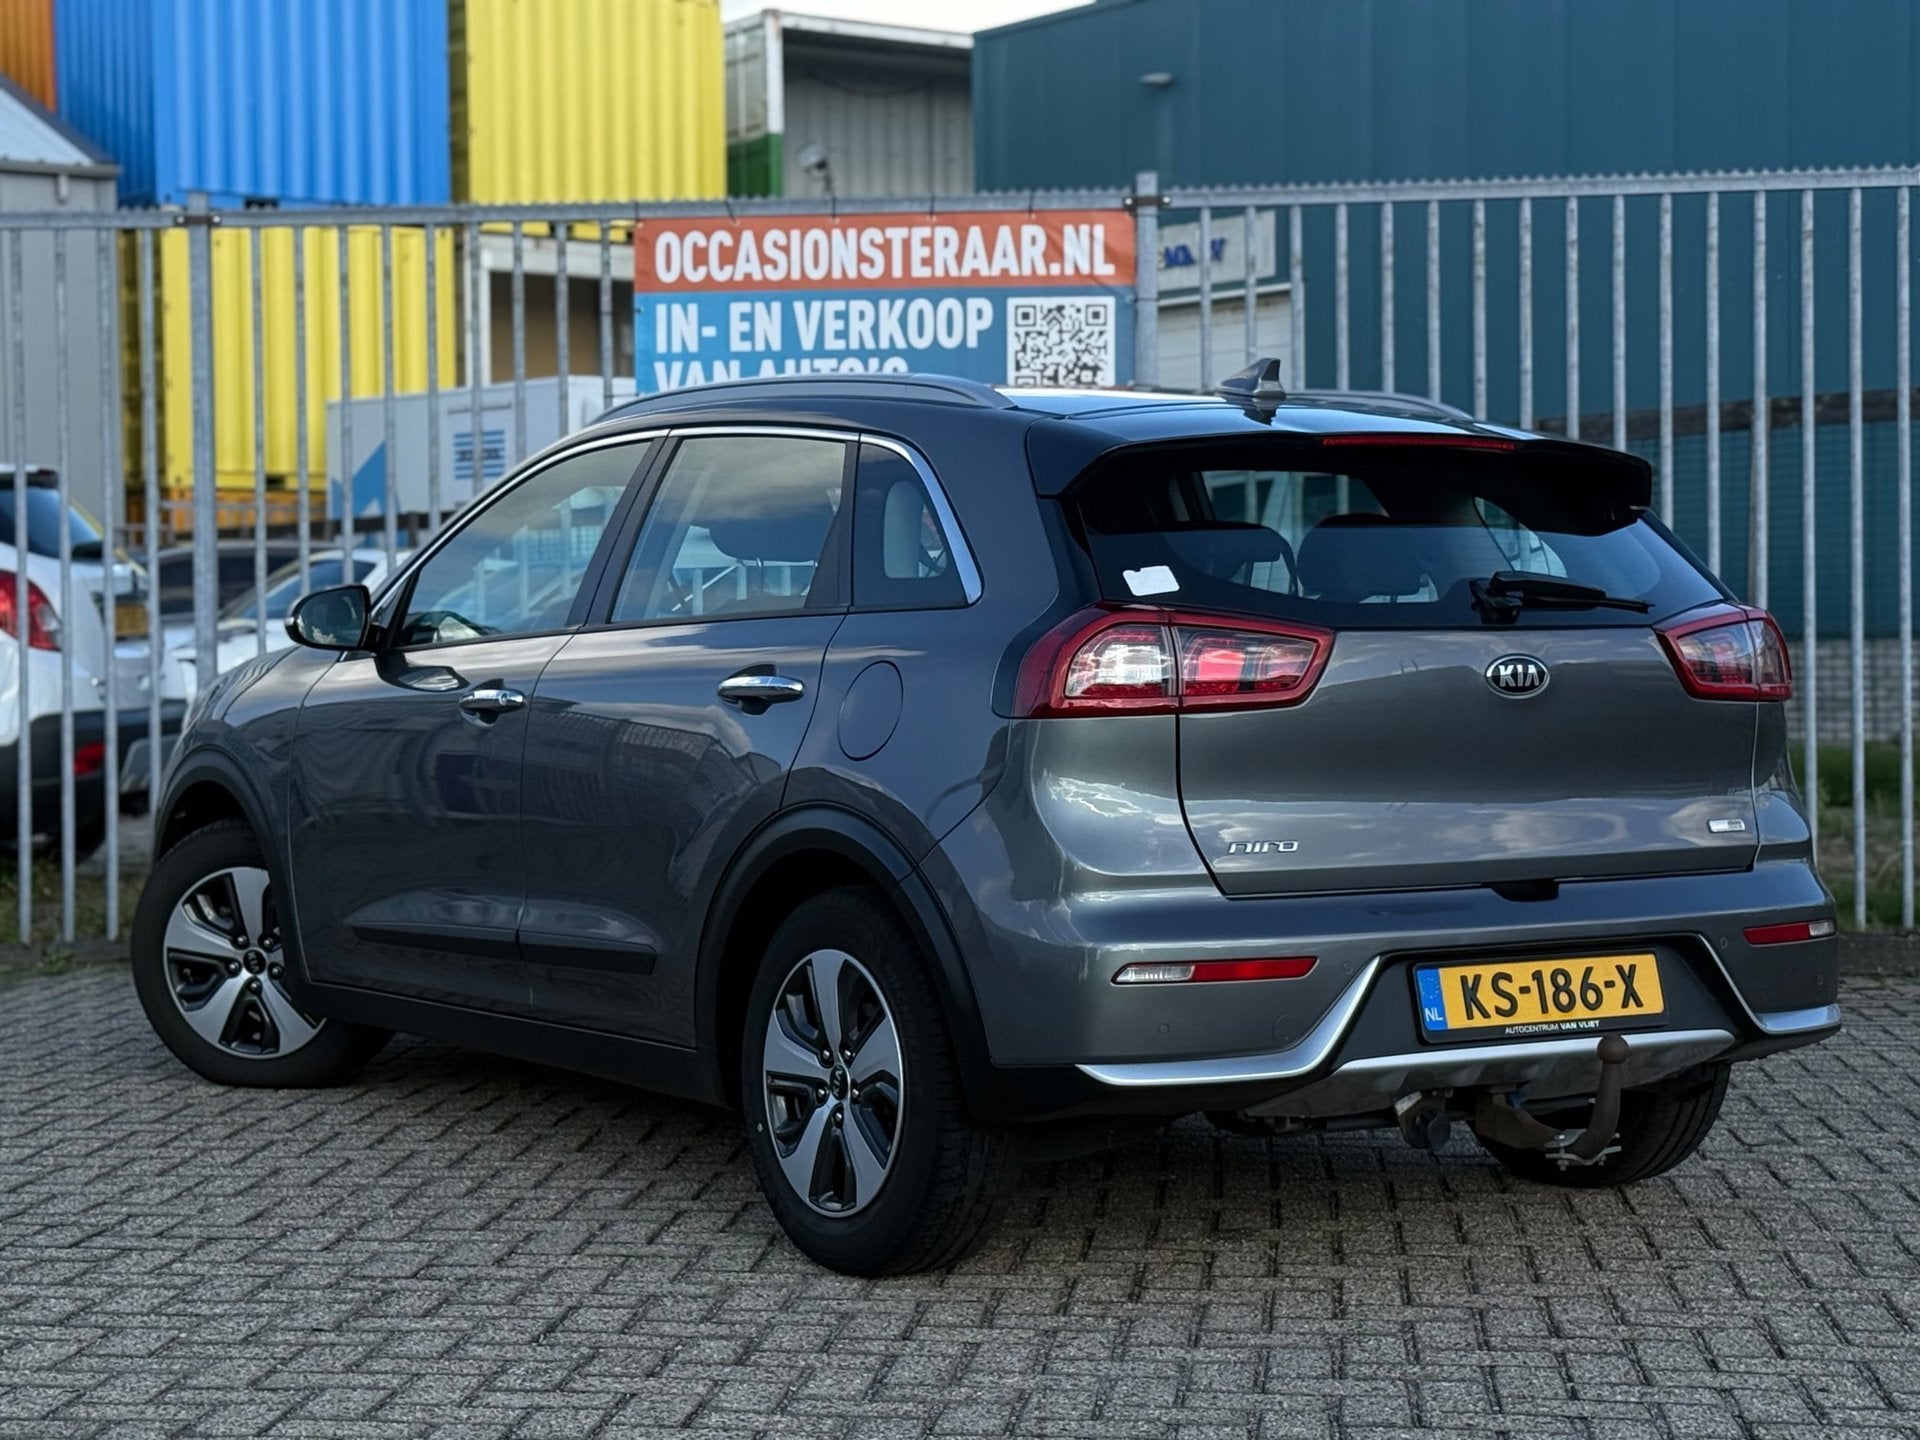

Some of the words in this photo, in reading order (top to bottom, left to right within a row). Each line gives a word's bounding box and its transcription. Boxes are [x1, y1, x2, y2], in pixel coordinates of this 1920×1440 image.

[655, 223, 1116, 284] OCCASIONSTERAAR.NL
[656, 303, 717, 354] IN-
[729, 301, 782, 352] EN
[793, 297, 994, 351] VERKOOP
[1498, 664, 1540, 687] KIA
[1459, 963, 1644, 1021] KS-186-X
[1424, 1006, 1443, 1023] NL
[1505, 1023, 1559, 1035] AUTOCENTRUM
[1560, 1021, 1577, 1030] VAN
[1578, 1019, 1600, 1029] VLIET
